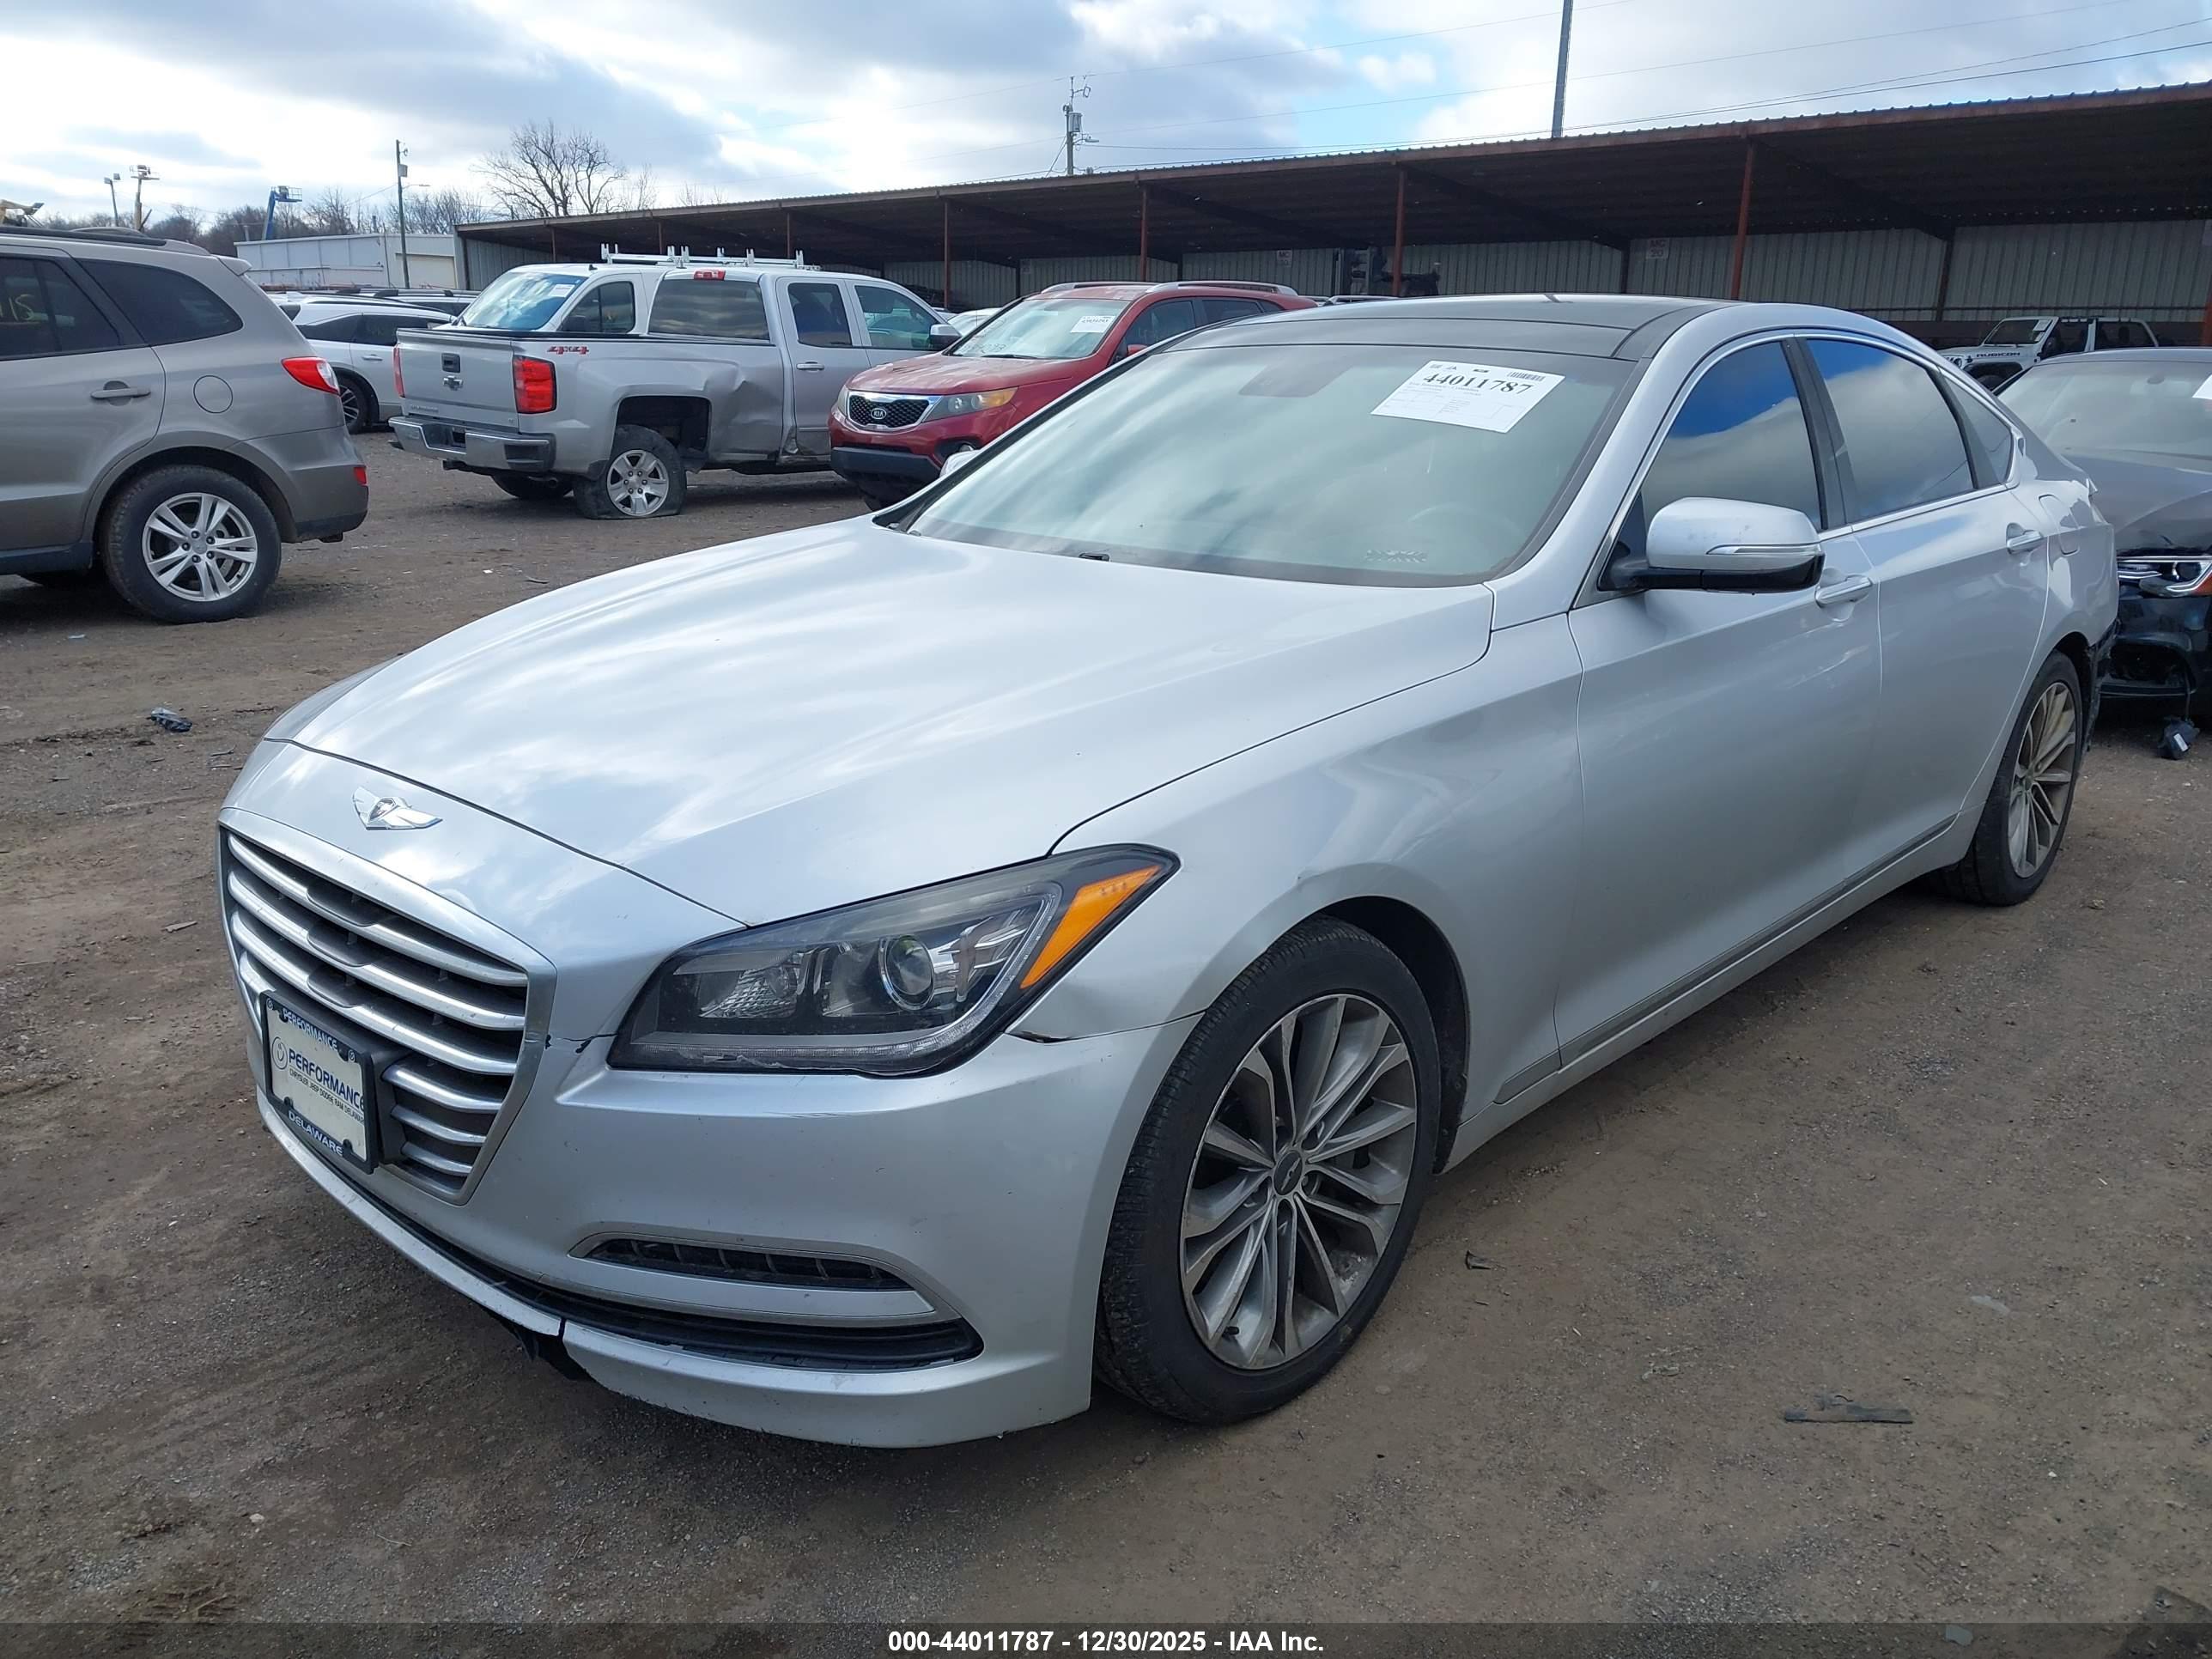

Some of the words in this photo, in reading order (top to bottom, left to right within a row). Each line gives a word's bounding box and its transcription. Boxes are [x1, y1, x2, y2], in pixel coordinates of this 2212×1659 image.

[1423, 373, 1534, 395] 44011787
[283, 1007, 337, 1050] PERFORMANCE
[289, 1110, 343, 1157] DELAWARE
